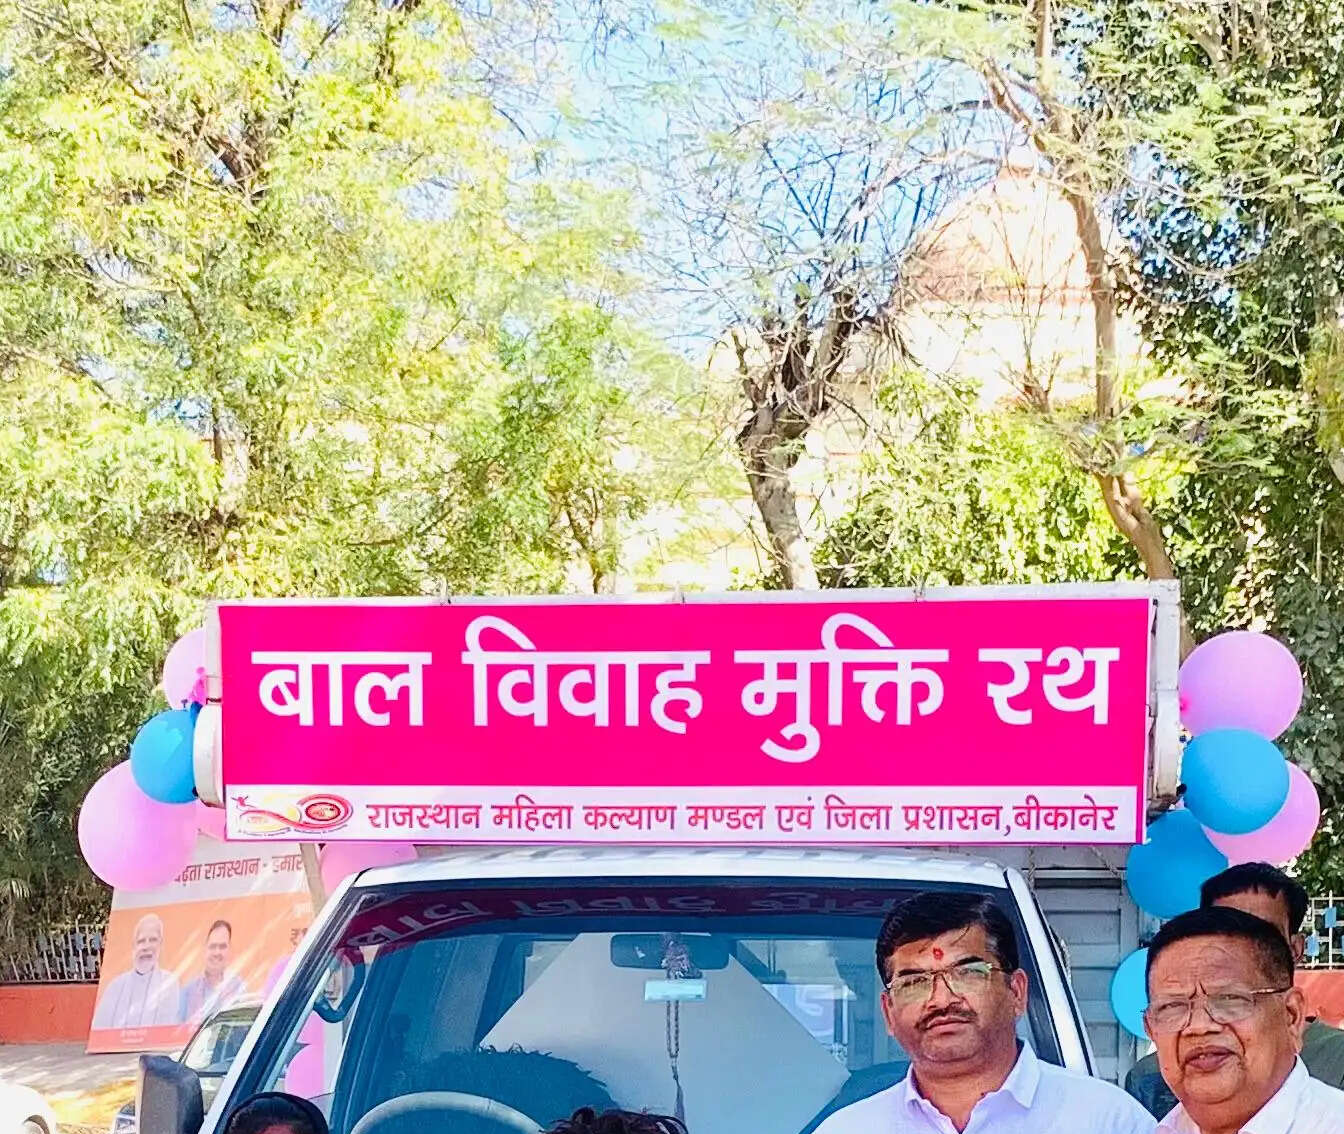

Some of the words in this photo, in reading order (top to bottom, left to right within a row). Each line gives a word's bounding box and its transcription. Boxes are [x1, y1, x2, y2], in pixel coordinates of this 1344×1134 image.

[251, 651, 433, 727] बाल
[461, 615, 711, 735] विवाह
[733, 612, 949, 763] मुक्ति
[978, 646, 1120, 726] रथ
[366, 803, 481, 831] राजस्थान
[490, 794, 574, 832] महिला
[582, 803, 677, 831] कल्याण
[687, 804, 766, 831] मण्डल
[775, 795, 815, 832] एवं
[823, 794, 893, 832] जिला
[204, 857, 261, 880] राजस्थान
